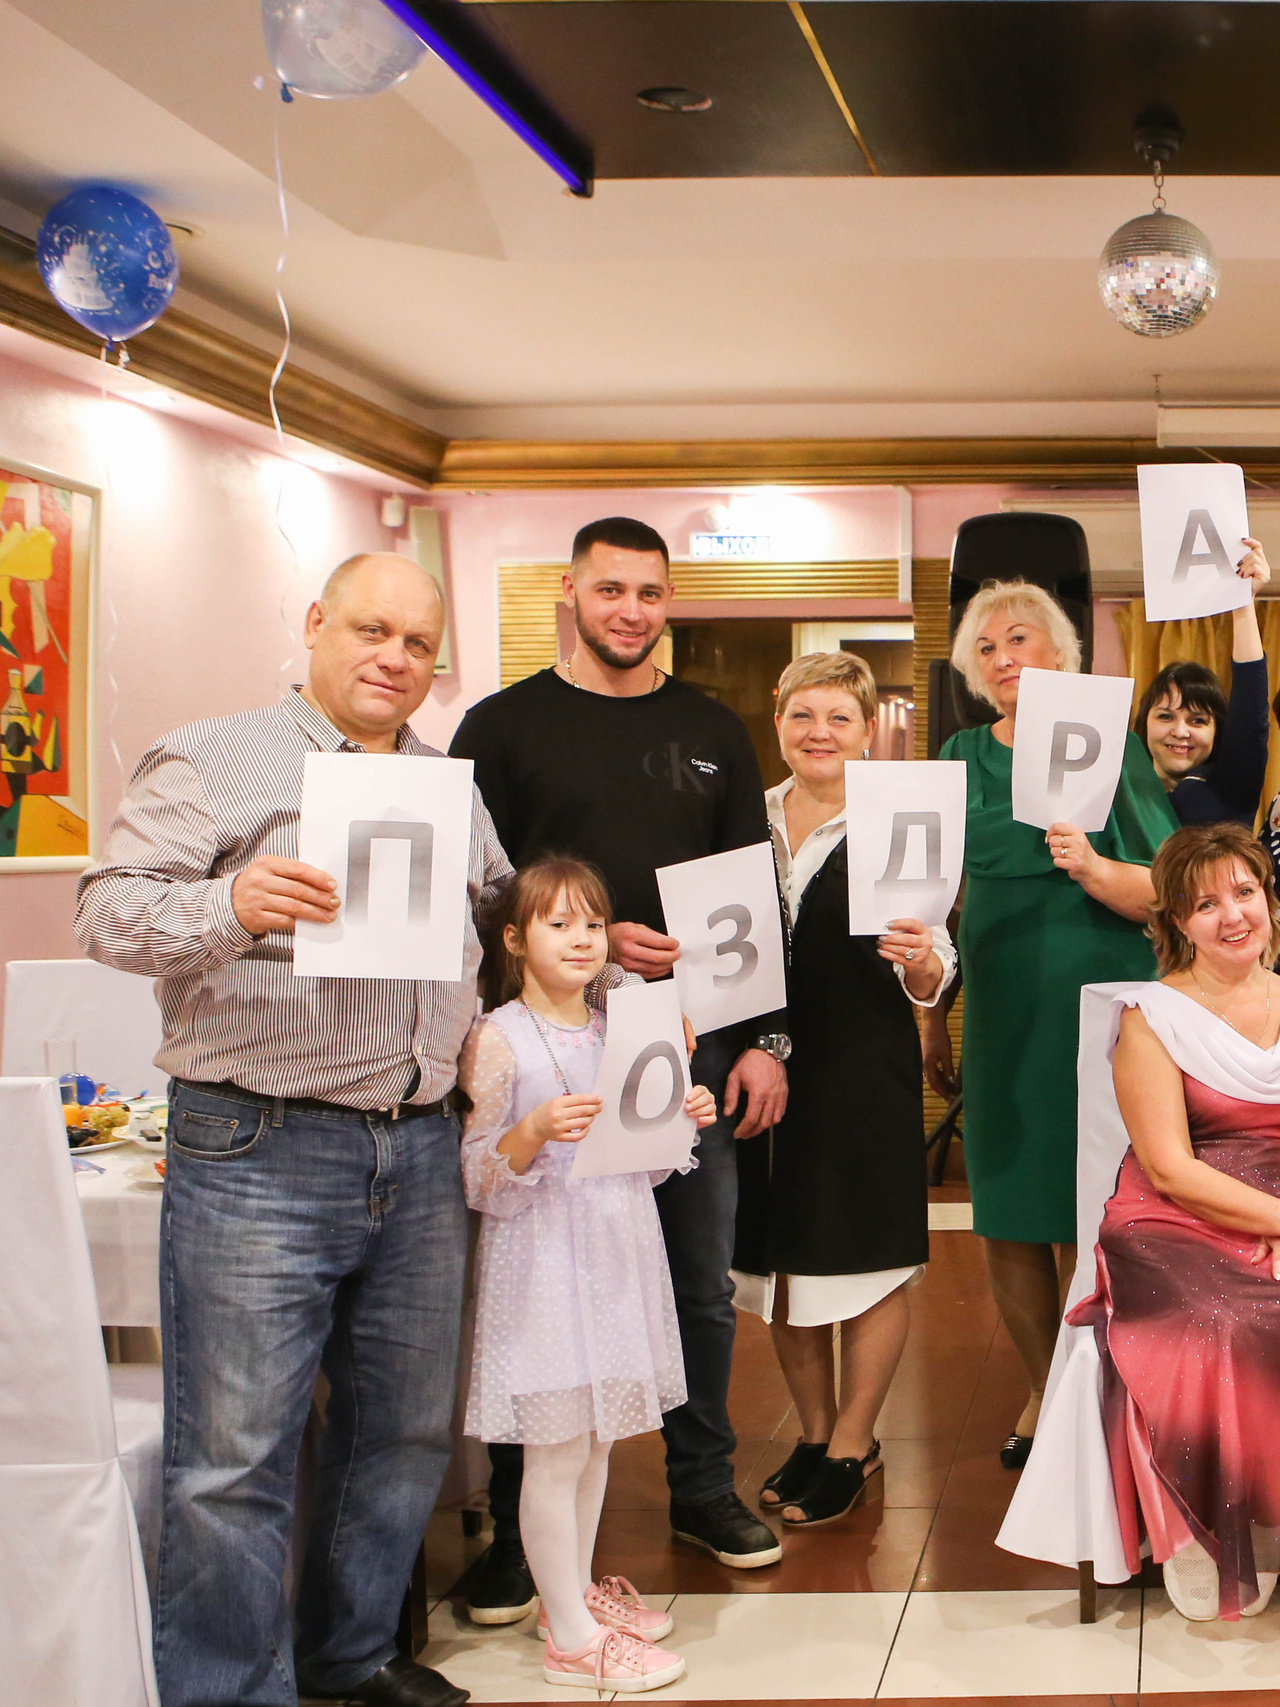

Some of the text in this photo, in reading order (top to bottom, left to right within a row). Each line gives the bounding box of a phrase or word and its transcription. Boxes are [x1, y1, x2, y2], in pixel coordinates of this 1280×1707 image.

[1173, 508, 1231, 583] А
[1047, 721, 1102, 798] Р
[347, 820, 433, 926] П
[874, 811, 949, 891] Д
[706, 903, 759, 989] З
[619, 1040, 685, 1135] О
